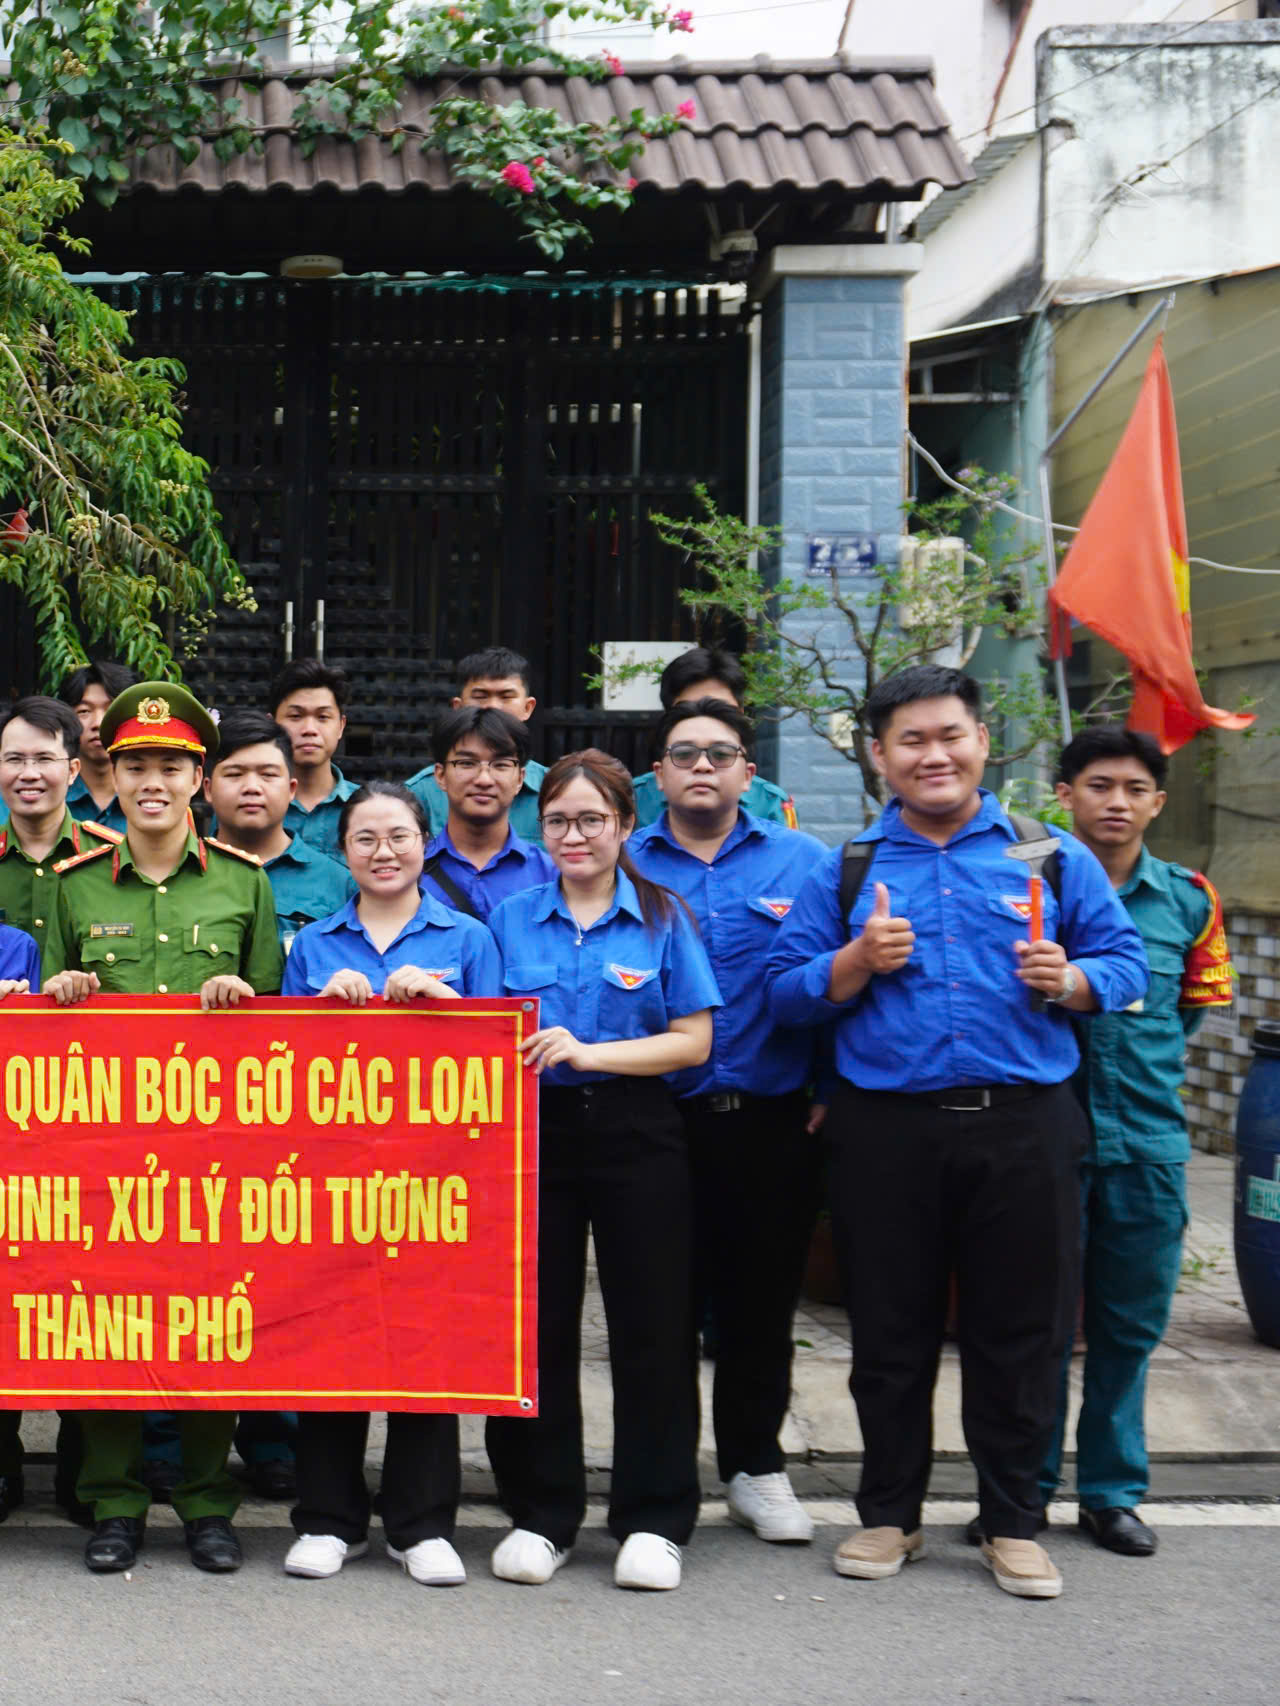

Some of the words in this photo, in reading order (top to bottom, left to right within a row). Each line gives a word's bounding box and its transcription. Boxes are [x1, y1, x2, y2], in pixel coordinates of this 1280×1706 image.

[5, 1041, 121, 1131] QUÂN
[135, 1042, 221, 1125] BÓC
[236, 1041, 295, 1125] GỠ
[307, 1042, 394, 1125] CÁC
[408, 1056, 504, 1139] LOẠI
[107, 1152, 170, 1243] XỬ
[179, 1162, 227, 1243] LÝ
[239, 1152, 312, 1245] ĐỐI
[325, 1170, 468, 1258] TƯỢNG
[13, 1279, 153, 1361] THÀNH
[168, 1271, 255, 1363] PHỐ
